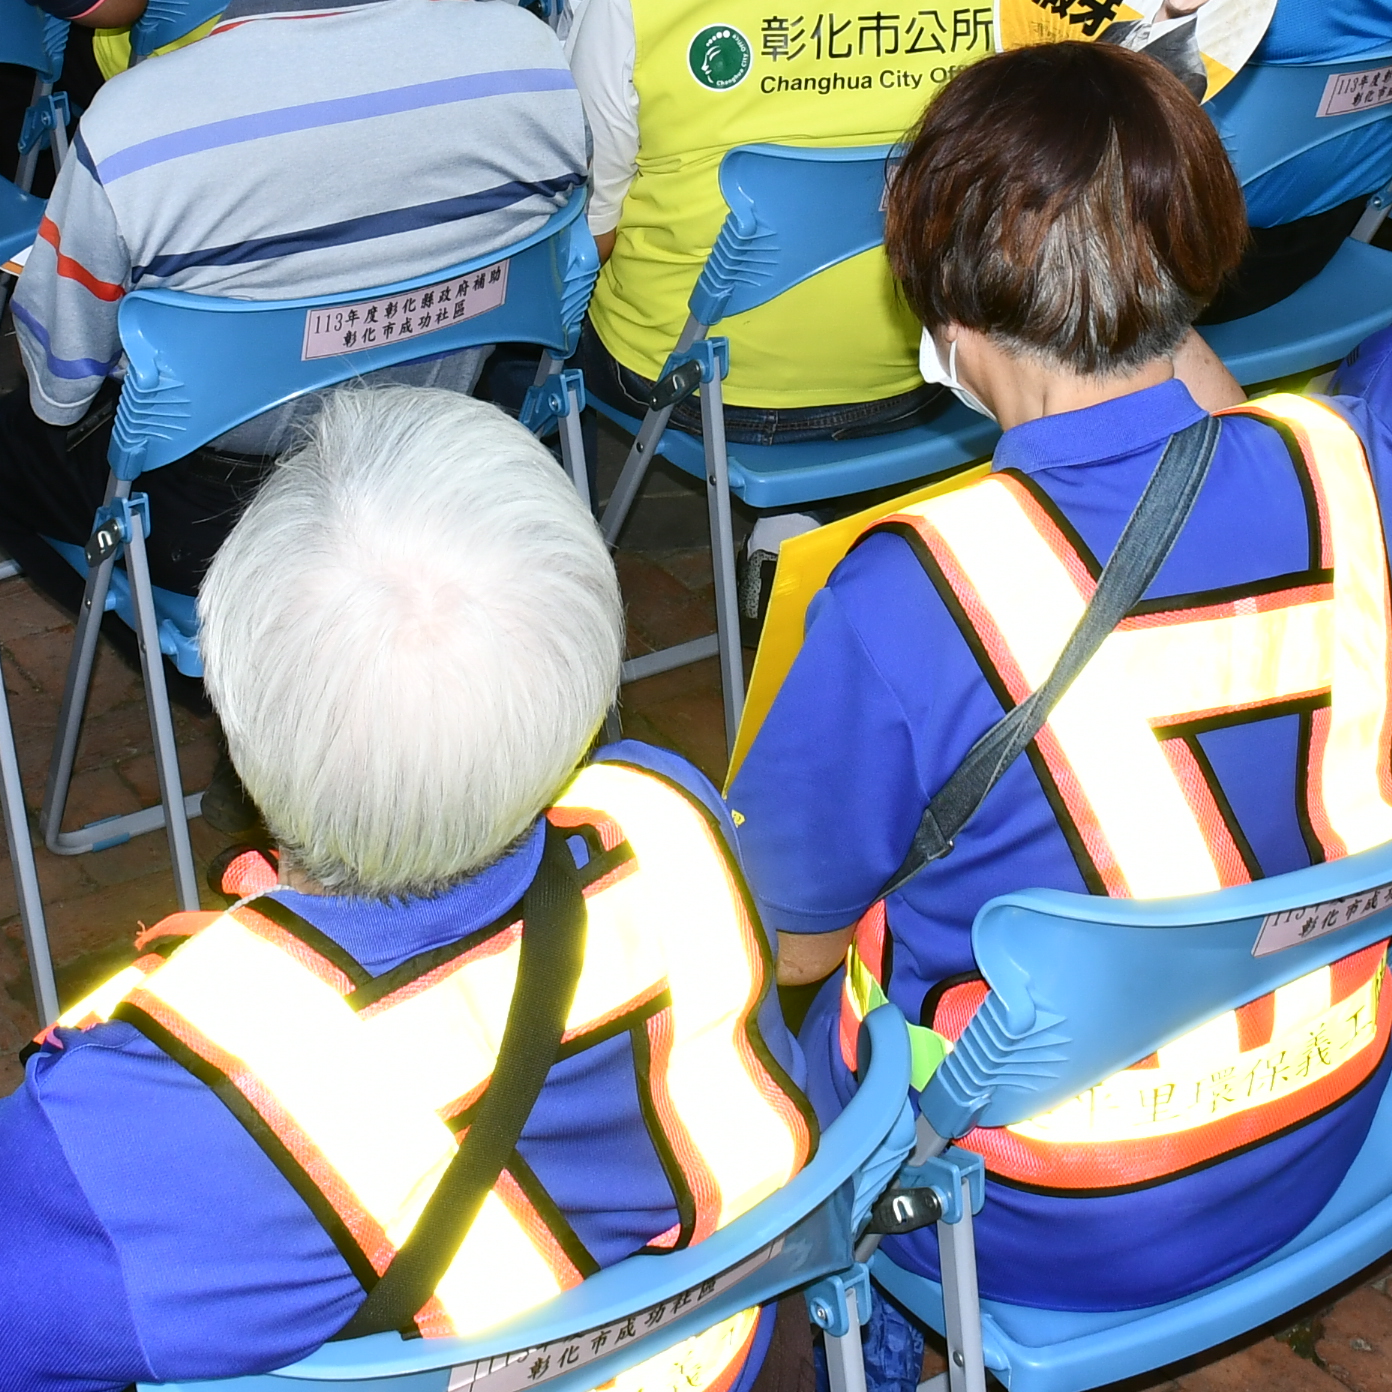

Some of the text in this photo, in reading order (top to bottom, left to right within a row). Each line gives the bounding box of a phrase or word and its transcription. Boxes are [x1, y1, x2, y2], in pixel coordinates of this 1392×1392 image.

[760, 8, 994, 63] 彰化市公所
[761, 68, 872, 96] Changhua
[880, 67, 924, 92] City
[313, 265, 502, 335] 113年度彰化縣政府補助
[342, 301, 465, 348] 彰化市成功社區
[528, 1278, 717, 1381] 彰化市成功社區
